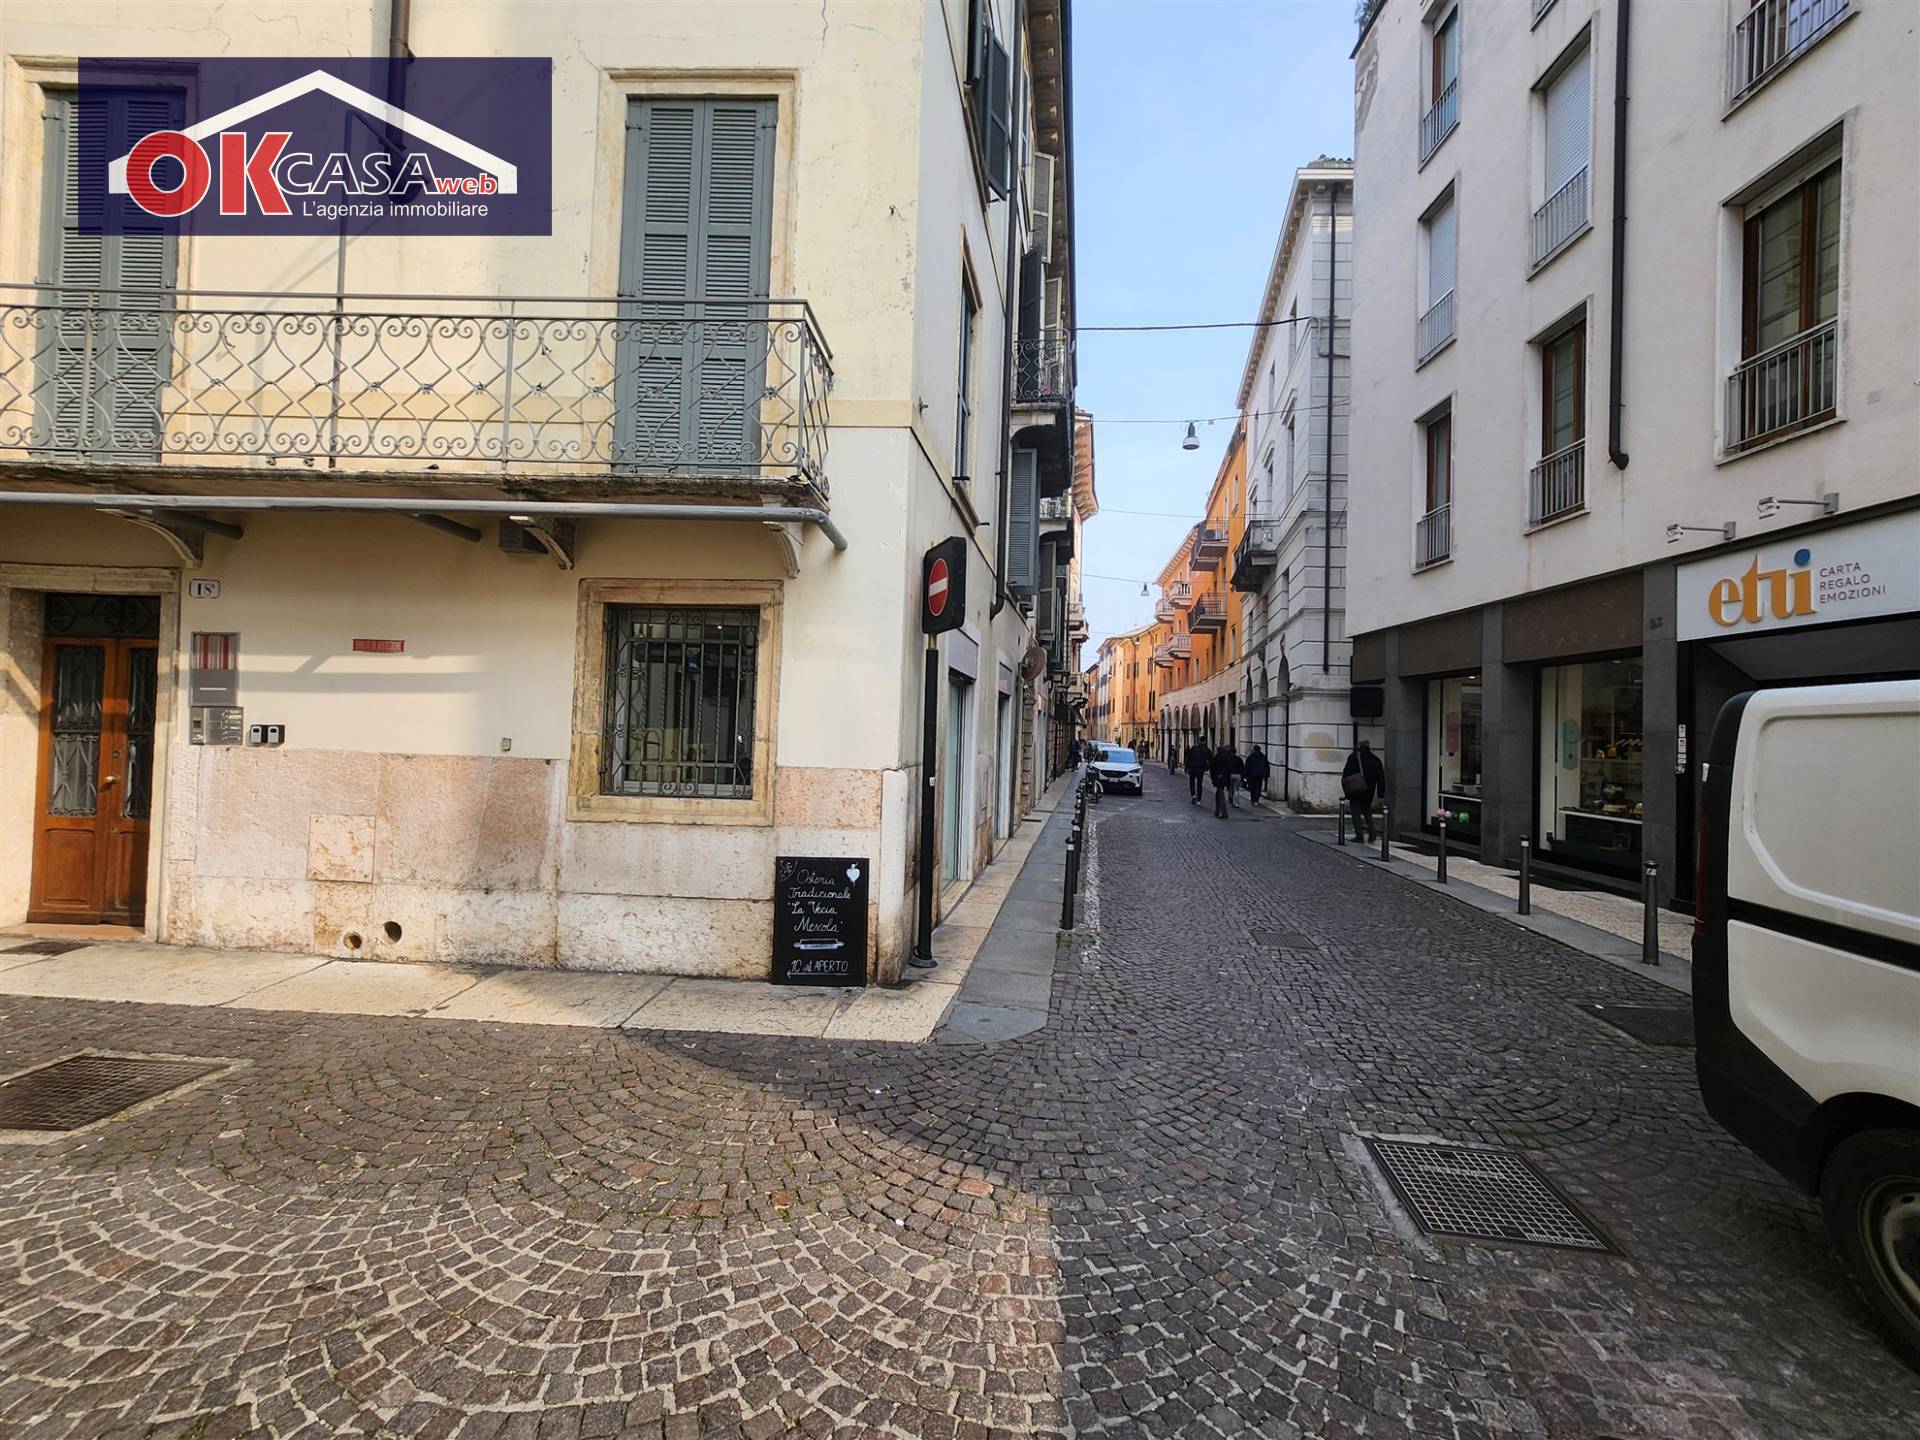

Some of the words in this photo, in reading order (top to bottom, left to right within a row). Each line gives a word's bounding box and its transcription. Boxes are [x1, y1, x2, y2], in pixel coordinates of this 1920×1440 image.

[1819, 561, 1861, 578] CARTA
[1708, 548, 1816, 627] etui
[1819, 573, 1871, 591] REGALO
[1819, 585, 1887, 604] EMOZIONI
[797, 869, 837, 885] Osteria
[788, 887, 851, 899] Tradizionale
[814, 960, 849, 972] APERTO
